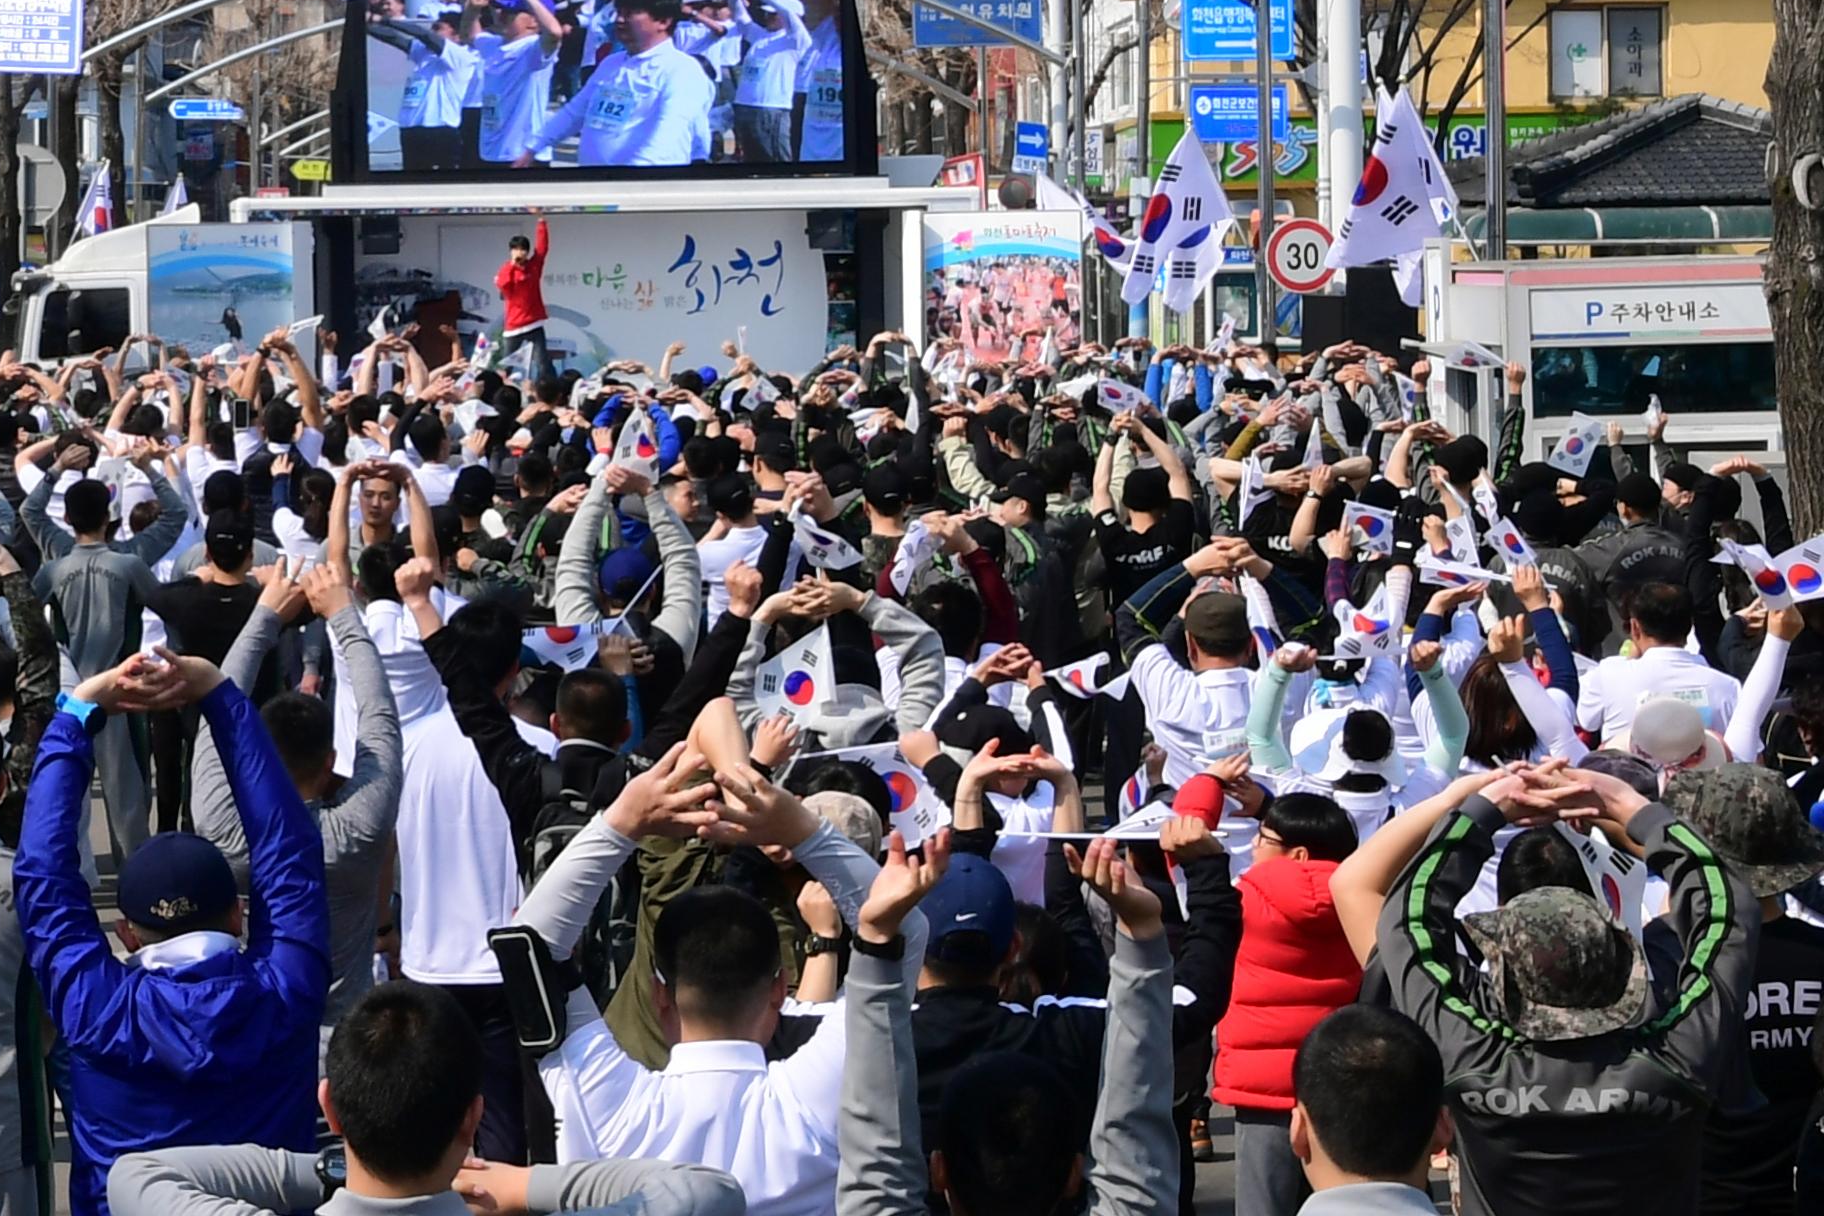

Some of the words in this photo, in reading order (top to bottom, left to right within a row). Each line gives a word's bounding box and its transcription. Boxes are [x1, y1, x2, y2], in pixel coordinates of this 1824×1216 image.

[1192, 6, 1285, 25] 화천읍행정복터
[597, 101, 625, 117] 182
[1285, 242, 1320, 271] 30
[667, 233, 785, 316] 화천
[1586, 301, 1604, 325] P
[1610, 300, 1721, 324] 주차안내소
[1268, 535, 1293, 551] KO
[1750, 1026, 1814, 1051] RMY
[1460, 1085, 1552, 1117] ROK
[1563, 1087, 1693, 1116] ARMY
